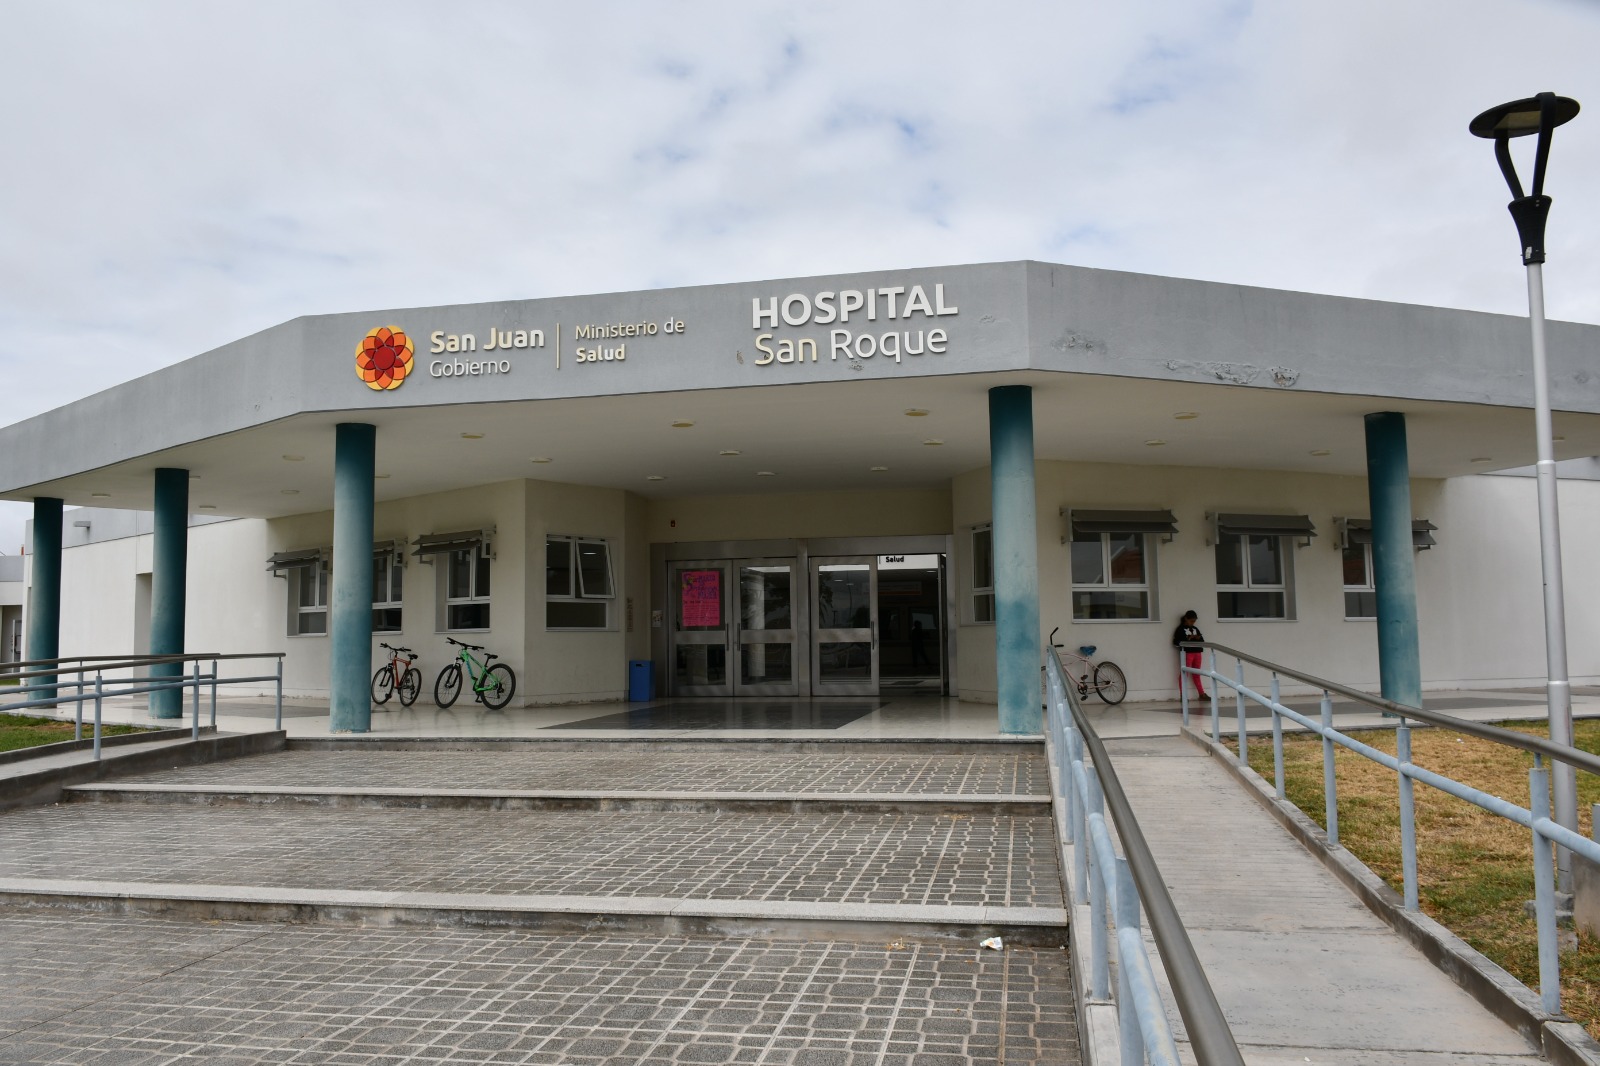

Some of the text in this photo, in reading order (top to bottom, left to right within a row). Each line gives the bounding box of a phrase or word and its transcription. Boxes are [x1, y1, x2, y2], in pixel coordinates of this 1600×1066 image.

[752, 283, 959, 329] HOSPITAL
[575, 317, 685, 340] Ministerio de
[430, 327, 545, 354] San Juan
[754, 328, 948, 365] San Roque
[575, 344, 626, 363] Salud
[429, 358, 511, 378] Gobierno
[885, 555, 905, 563] Salud
